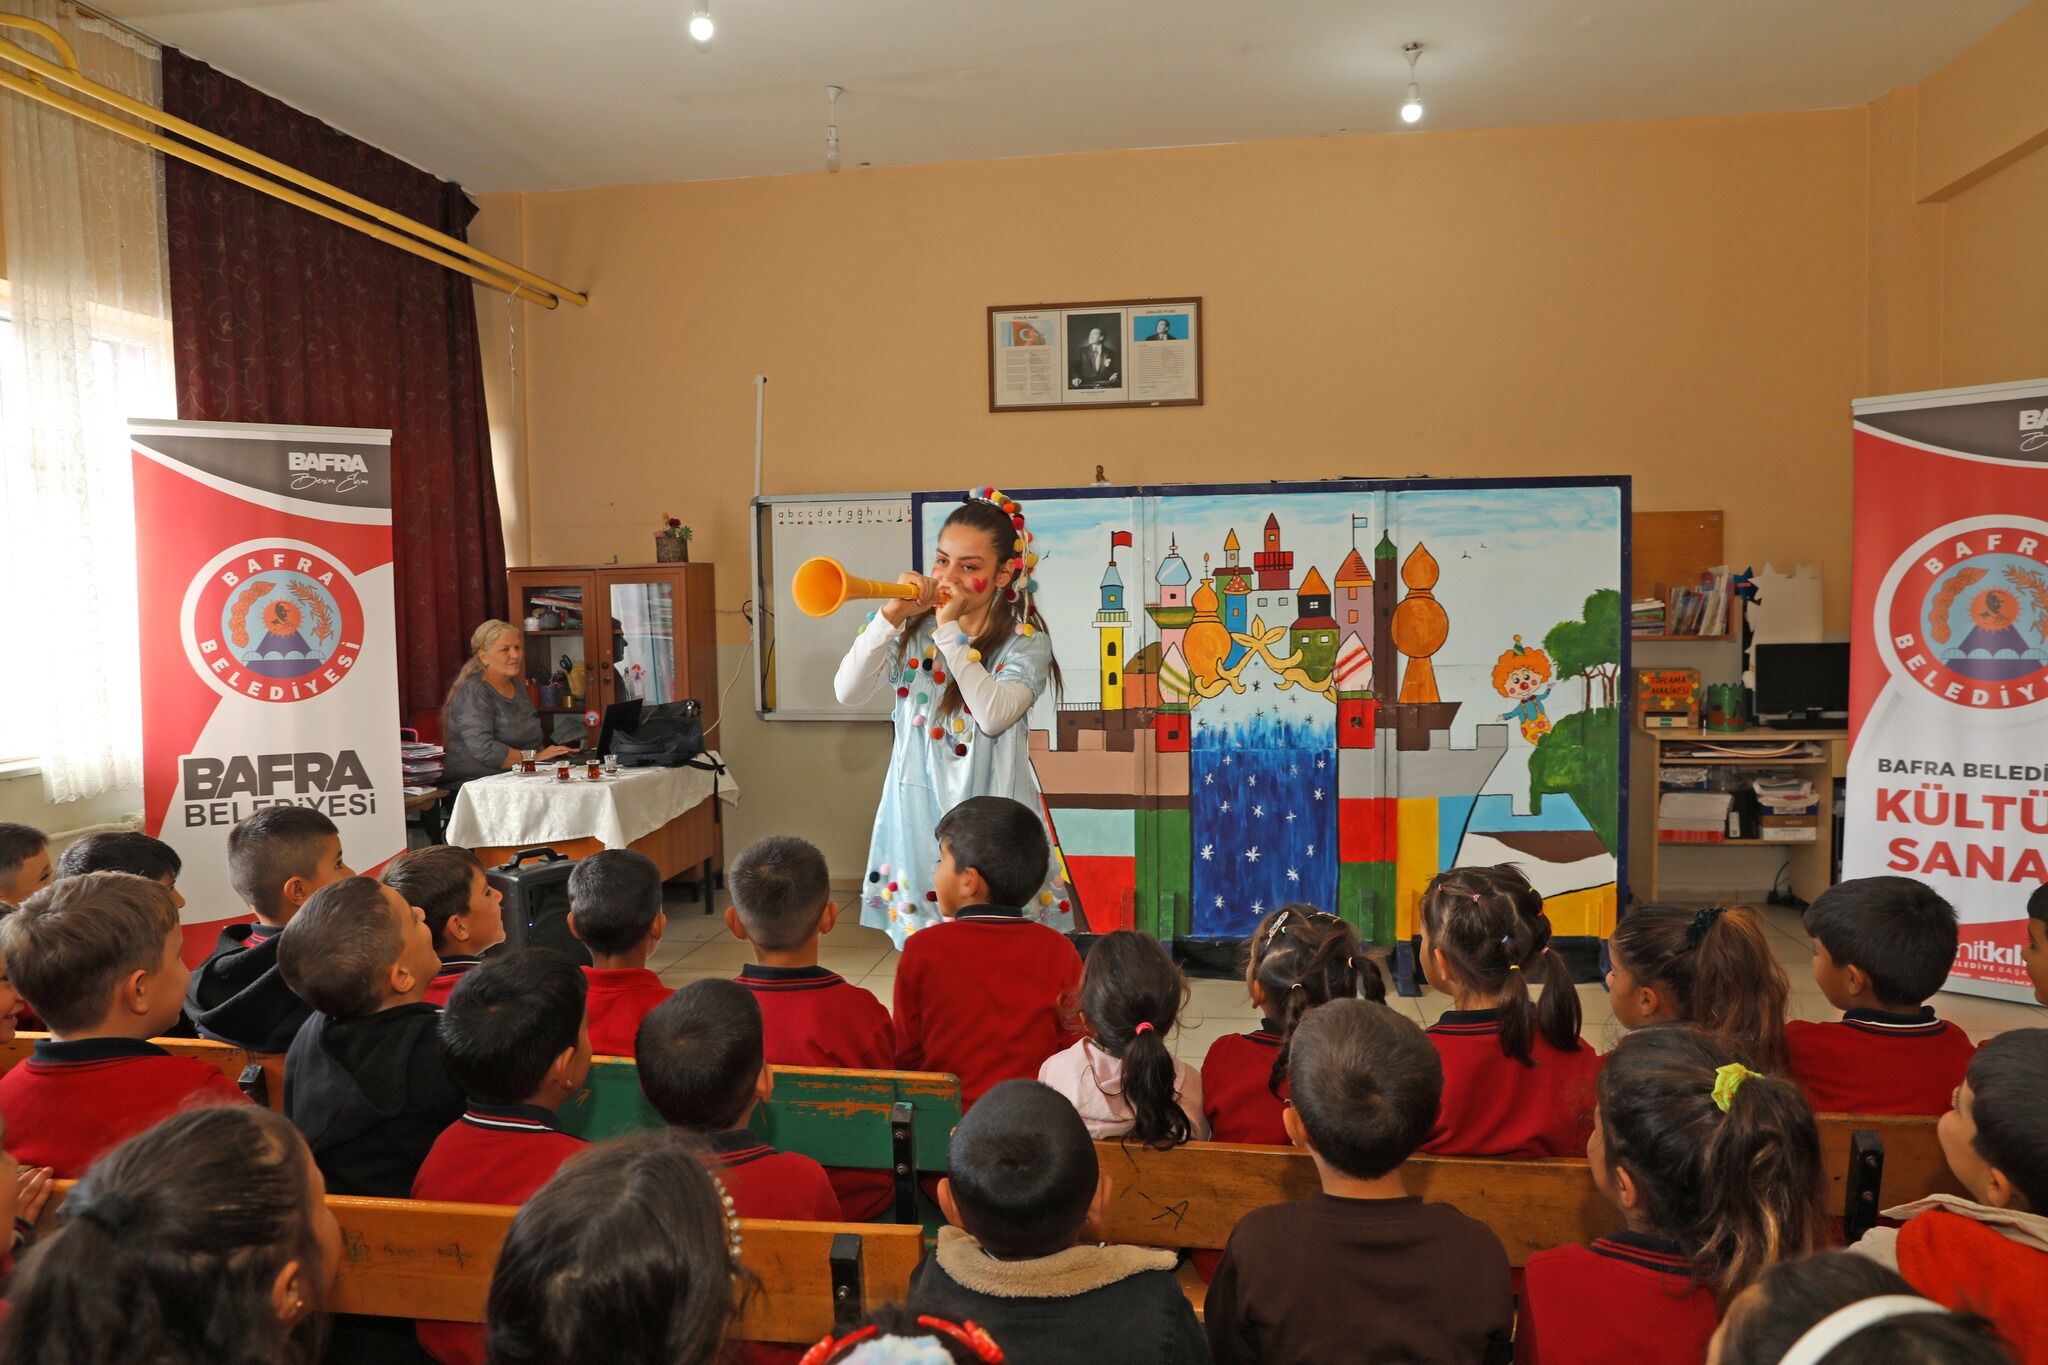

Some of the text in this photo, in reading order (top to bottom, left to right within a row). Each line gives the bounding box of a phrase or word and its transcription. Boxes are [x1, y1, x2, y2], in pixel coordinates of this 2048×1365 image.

[288, 452, 368, 473] BAFRA
[221, 553, 333, 588] BAFRA
[1925, 534, 2048, 575] BAFR
[200, 638, 361, 701] BELEDİYESİ
[1895, 633, 2048, 706] BELEDİY
[183, 750, 374, 801] BAFRA
[1877, 758, 1956, 777] BAFRA
[1876, 783, 2048, 835] KÜLTÜ
[1886, 837, 2048, 885] SANA
